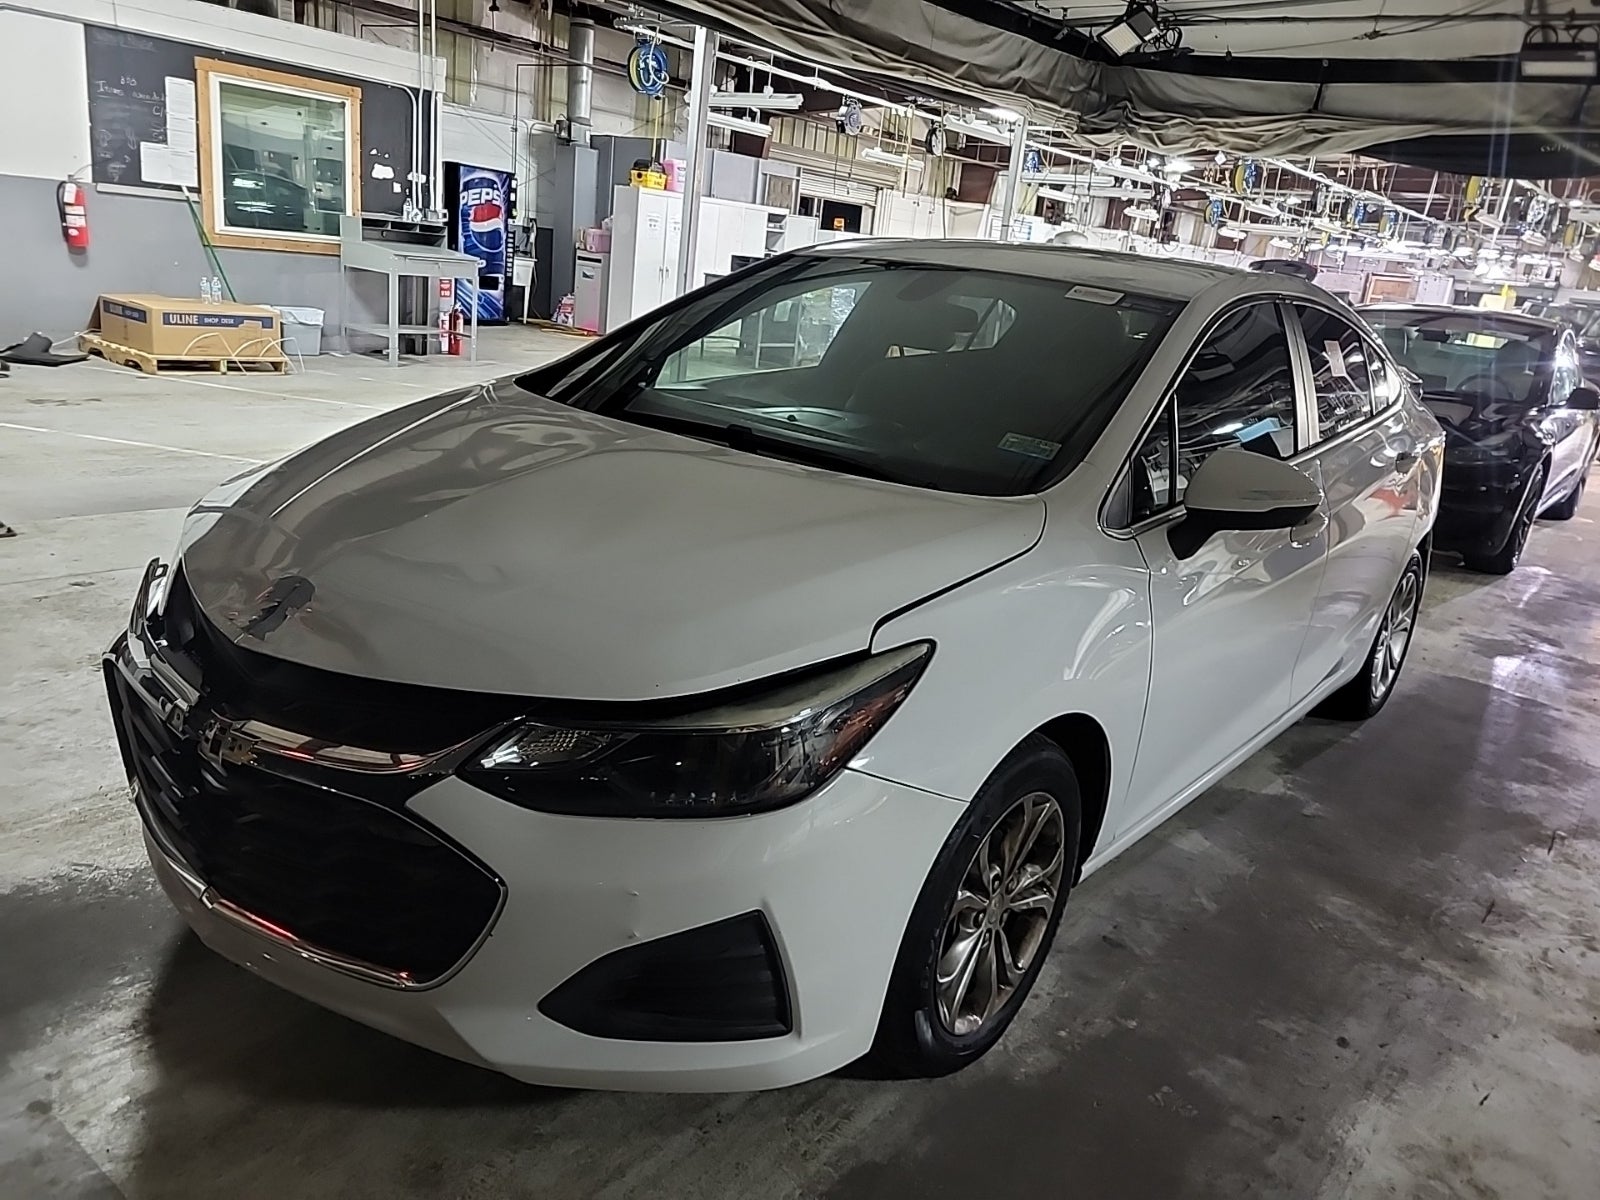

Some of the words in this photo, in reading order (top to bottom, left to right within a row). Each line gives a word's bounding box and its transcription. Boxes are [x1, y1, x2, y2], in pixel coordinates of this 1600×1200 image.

[460, 188, 502, 207] PEPS
[169, 313, 199, 325] ULINE
[204, 317, 219, 325] SHOP
